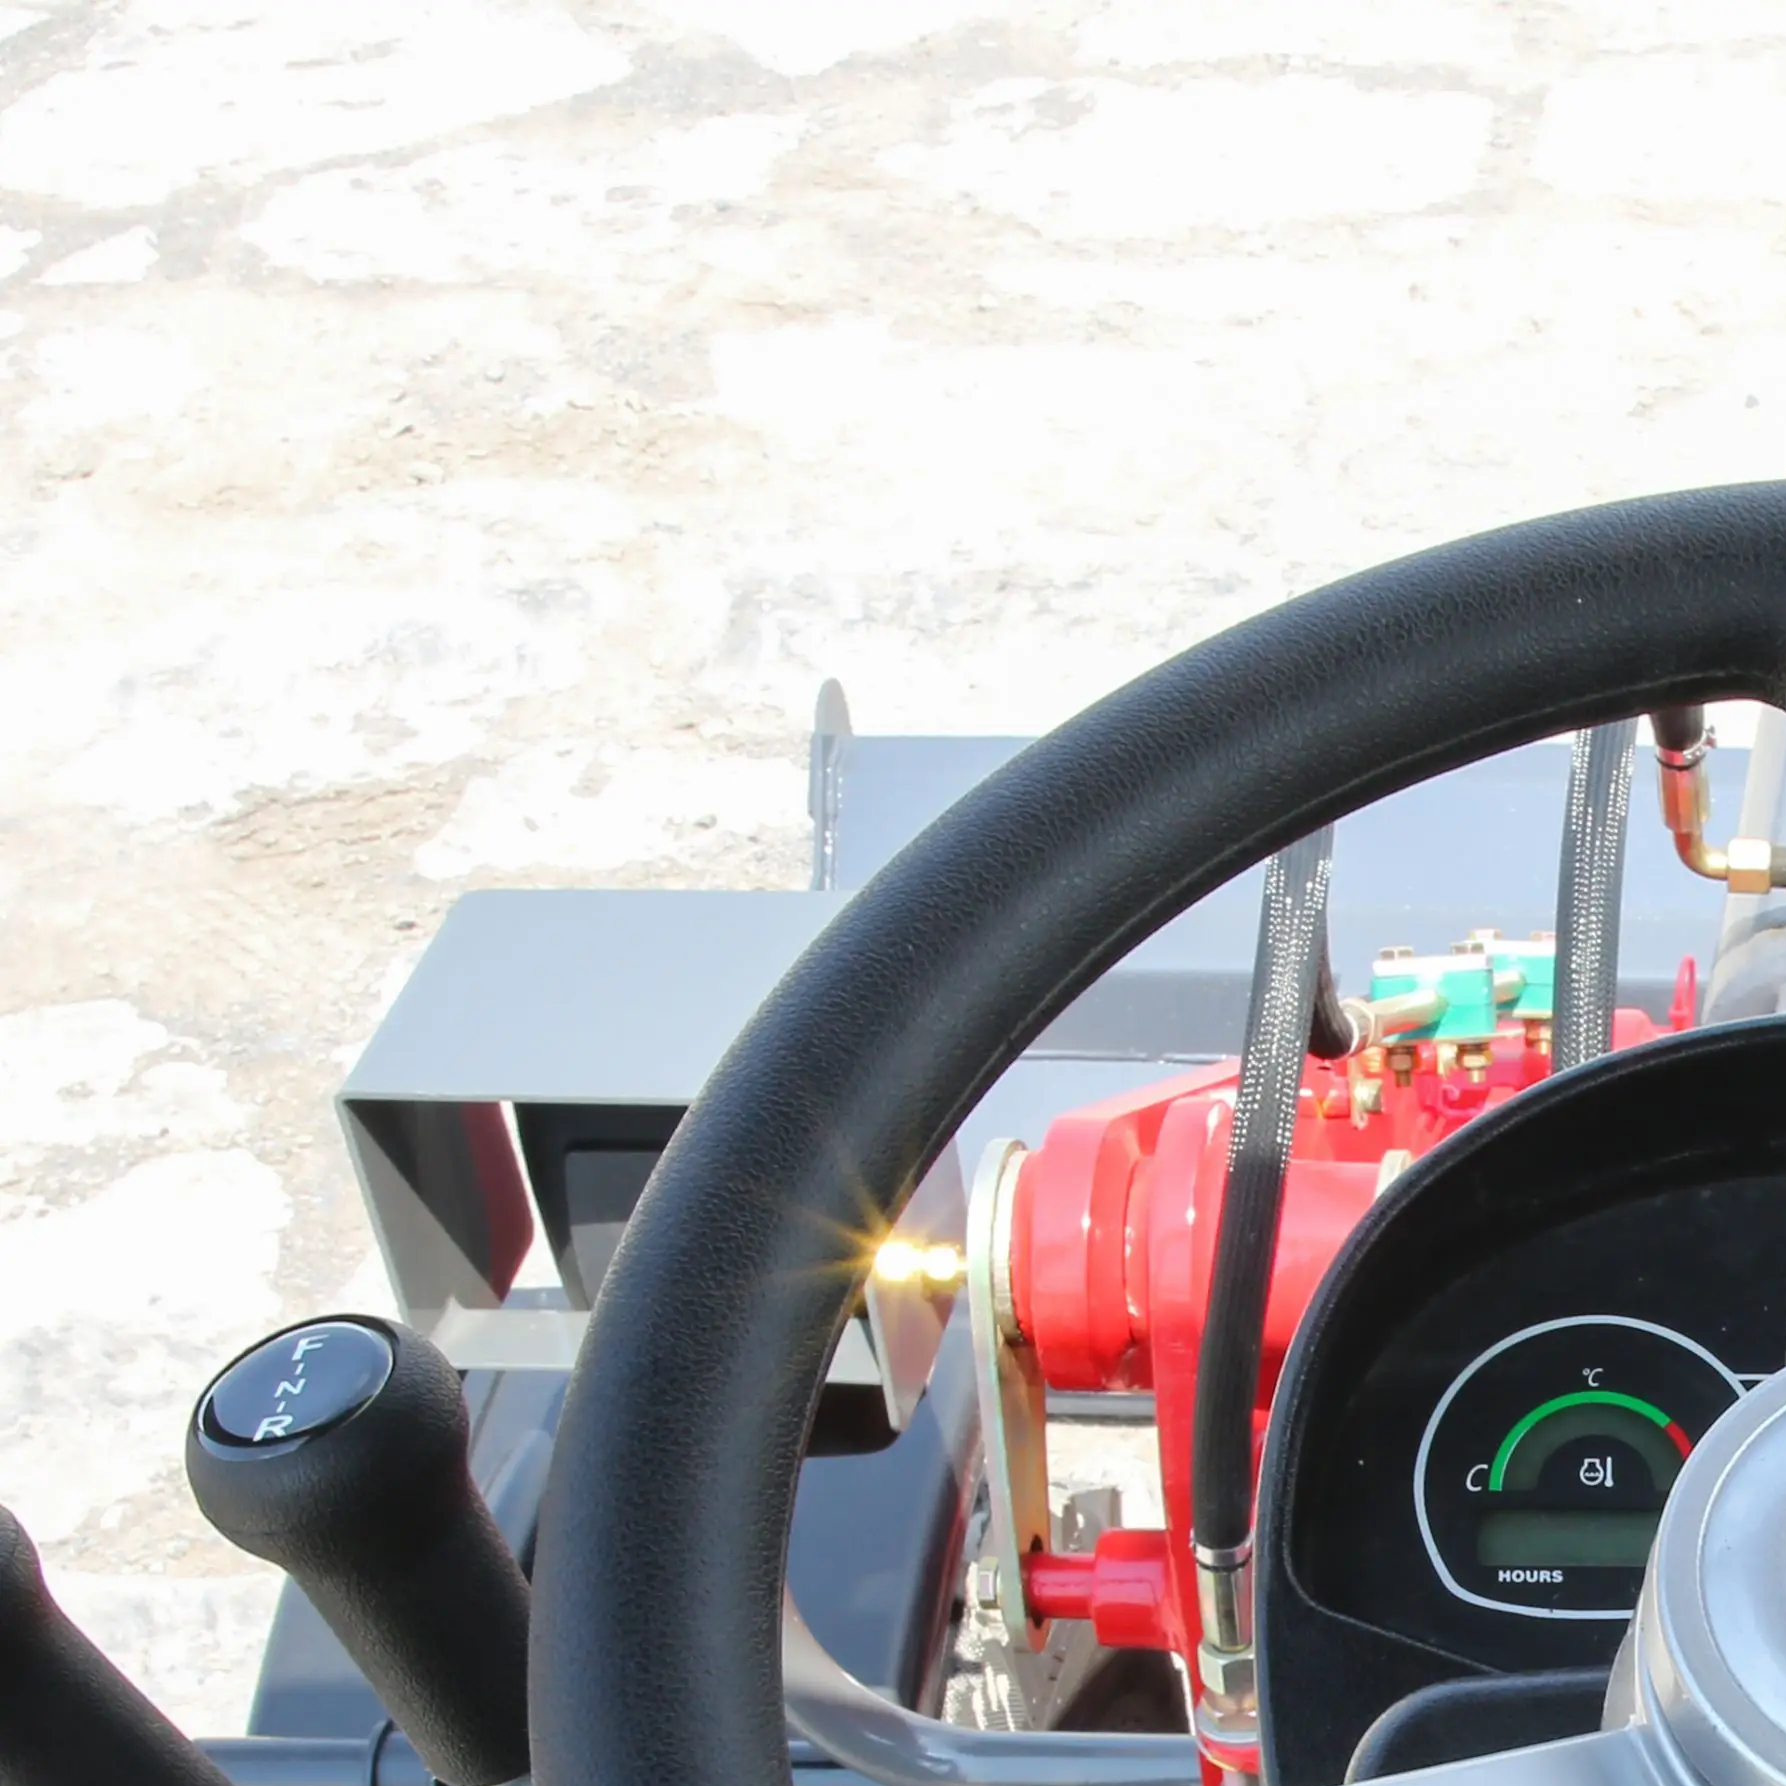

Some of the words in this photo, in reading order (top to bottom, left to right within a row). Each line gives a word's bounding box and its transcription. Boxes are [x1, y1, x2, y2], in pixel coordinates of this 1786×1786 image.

[291, 1334, 330, 1361] F
[273, 1378, 307, 1398] N
[252, 1415, 295, 1443] R
[1465, 1463, 1489, 1492] C
[1497, 1569, 1564, 1584] HOURS
